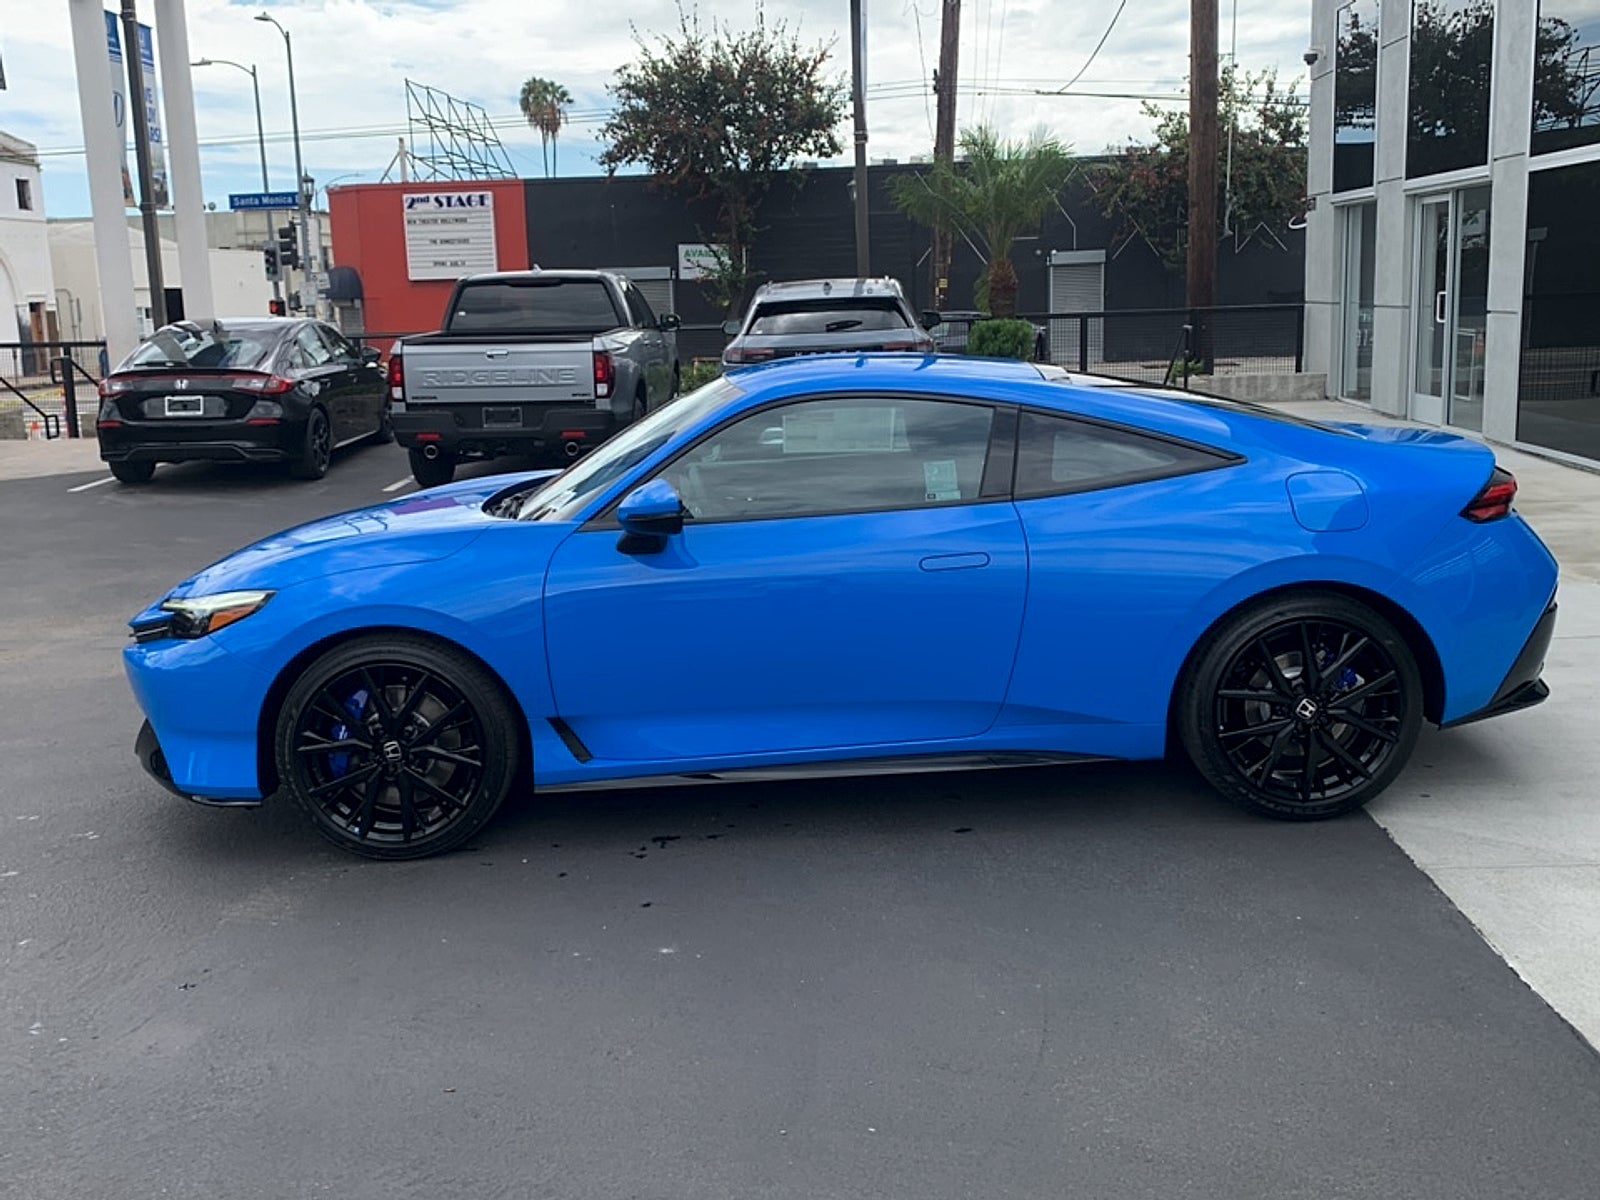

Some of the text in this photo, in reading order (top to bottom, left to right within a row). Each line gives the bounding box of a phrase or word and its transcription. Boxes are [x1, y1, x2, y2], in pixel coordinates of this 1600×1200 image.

[233, 196, 260, 207] Santa
[261, 195, 293, 205] Monica
[405, 194, 490, 209] 2nd STAGE
[422, 369, 577, 387] RIDGELINE
